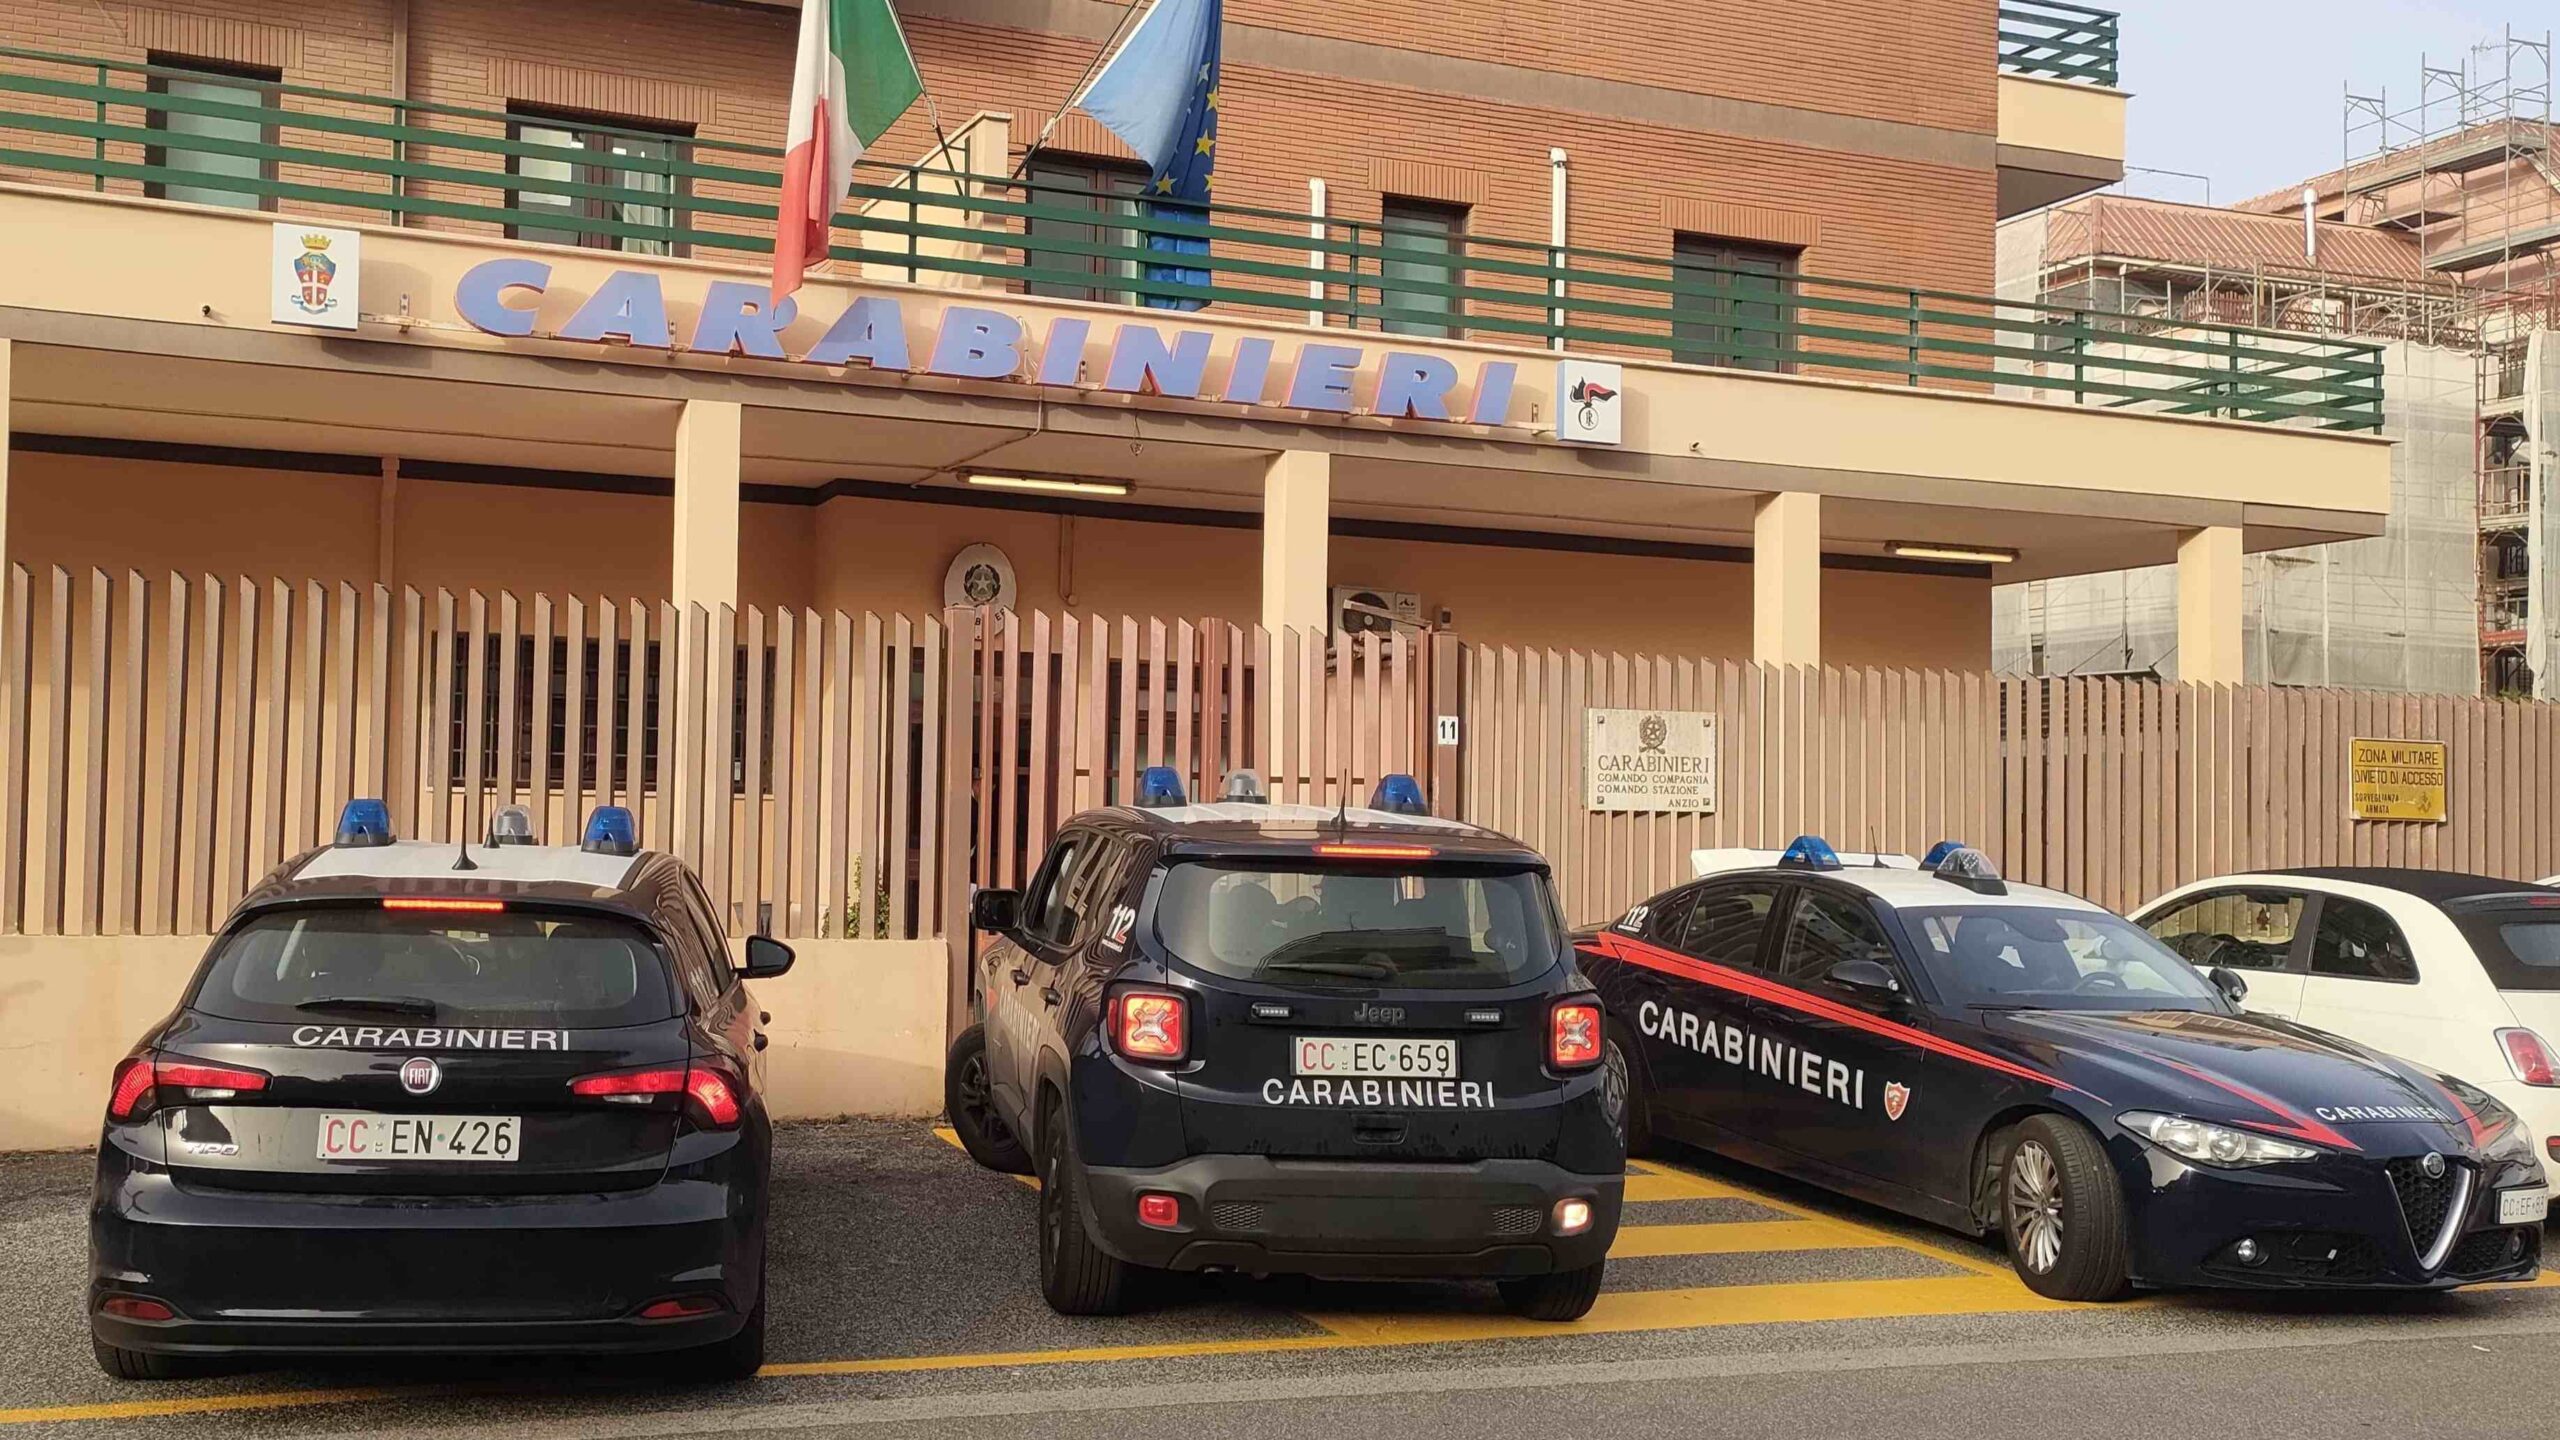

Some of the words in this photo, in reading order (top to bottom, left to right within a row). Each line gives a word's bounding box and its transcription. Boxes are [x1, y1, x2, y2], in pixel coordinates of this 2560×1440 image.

[453, 257, 1519, 427] CARABINIERI
[1439, 719, 1456, 740] 11
[1597, 754, 1709, 773] CARABINIERI
[2358, 748, 2387, 763] ZONA
[2391, 750, 2438, 765] MILITARE
[1597, 773, 1647, 783] COMANDO
[1651, 774, 1709, 785] COMPAGNIA
[2354, 769, 2387, 784] DIVIETO
[2390, 770, 2398, 784] DI
[2401, 771, 2443, 786] ACCESSO
[1597, 783, 1648, 794] COMANDO
[1652, 784, 1698, 795] STAZIONE
[2354, 792, 2399, 803] SORVEGLIANZA
[1667, 798, 1699, 808] ANZIO
[2365, 804, 2389, 814] ARMATA
[1106, 903, 1136, 945] 112
[1622, 905, 1649, 929] 112
[1353, 1002, 1407, 1026] Jeep
[291, 1024, 570, 1052] CARABINIERI
[1302, 1042, 1336, 1071] CC
[1354, 1043, 1387, 1072] EC
[1398, 1044, 1450, 1073] 659
[1638, 999, 1865, 1110] CARABINIERI
[409, 1067, 432, 1085] FIAT
[1261, 1077, 1496, 1109] CARABINIERI
[2314, 1105, 2453, 1121] CARABINIERI
[325, 1119, 369, 1154] CC
[390, 1120, 434, 1155] EN
[448, 1121, 512, 1156] 426
[186, 1141, 240, 1156] TIPO
